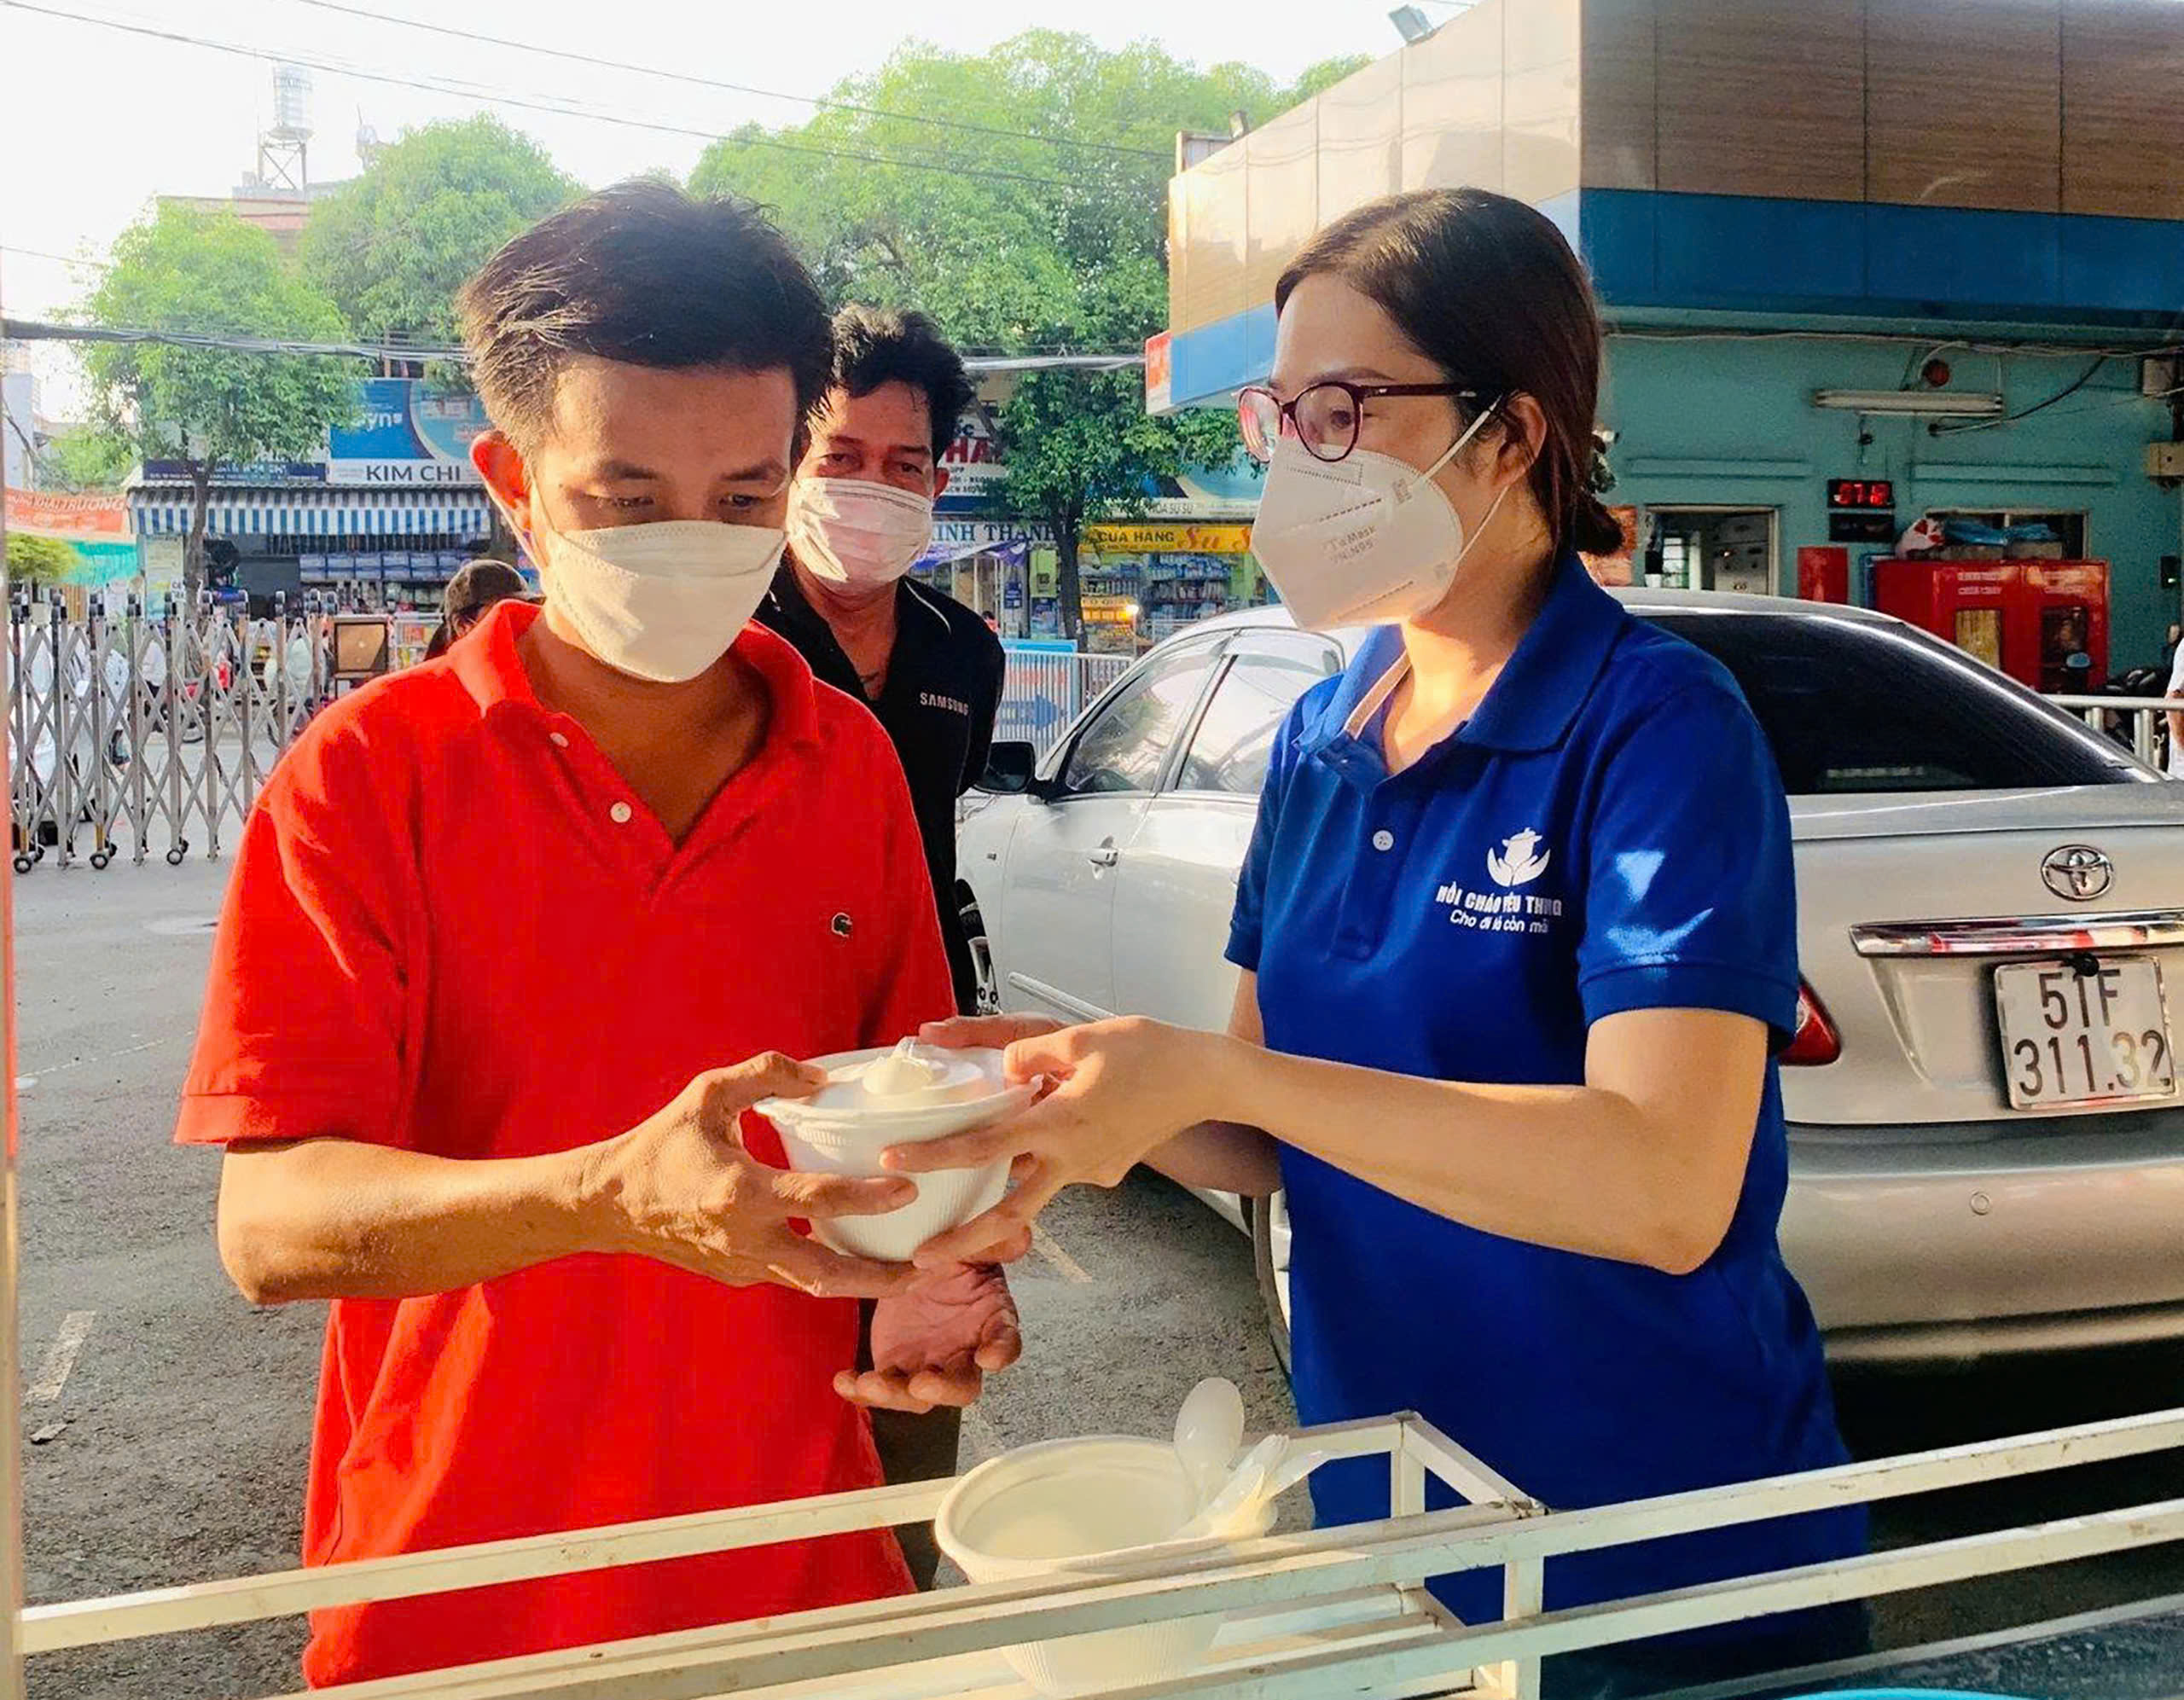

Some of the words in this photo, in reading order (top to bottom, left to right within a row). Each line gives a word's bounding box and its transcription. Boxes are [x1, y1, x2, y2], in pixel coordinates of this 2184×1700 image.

[365, 466, 413, 482] KIM
[420, 466, 462, 482] CHI
[1450, 908, 1478, 928] Cho
[2038, 968, 2121, 1030] 51F
[2013, 1029, 2165, 1098] 311.32
